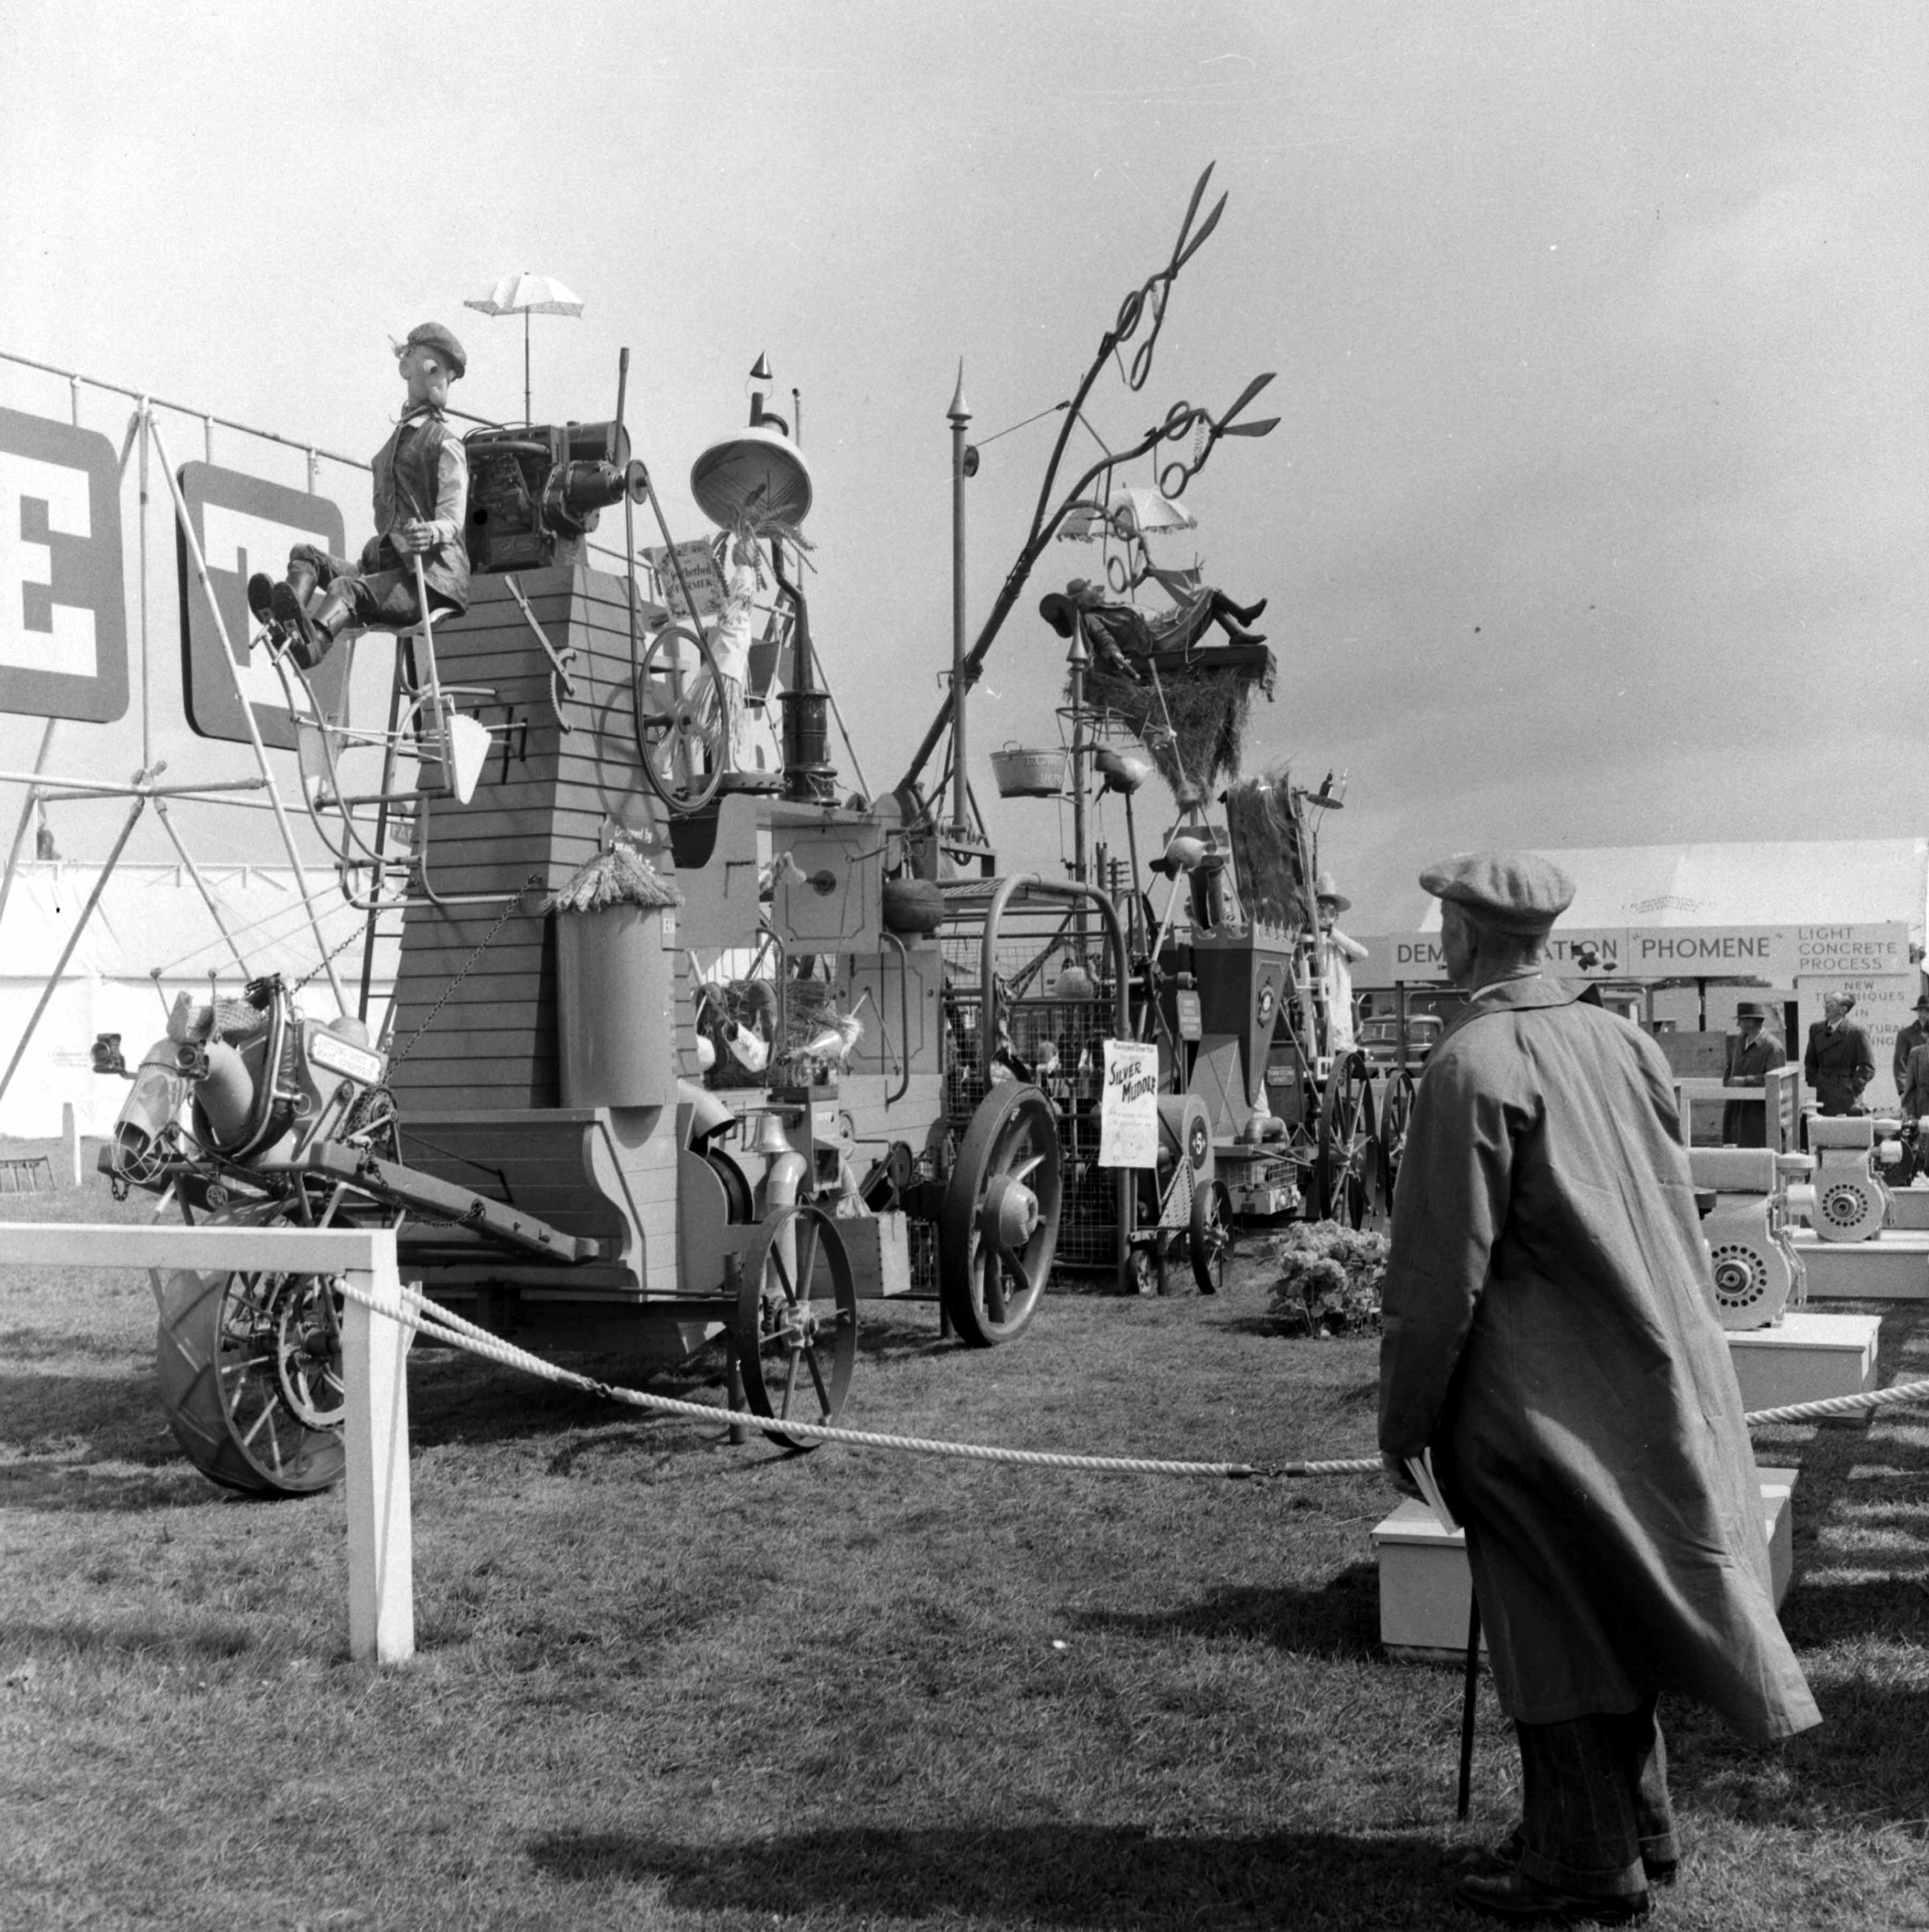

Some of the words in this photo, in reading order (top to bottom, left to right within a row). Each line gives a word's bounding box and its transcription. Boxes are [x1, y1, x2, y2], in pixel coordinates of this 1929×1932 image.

[1799, 927, 1852, 939] LIGHT
[1799, 942, 1897, 955] CONCRETE
[1800, 957, 1882, 970] PROCESS
[1845, 981, 1874, 990] NEW
[1856, 1009, 1868, 1017] IN
[1108, 1062, 1141, 1086] SILVER
